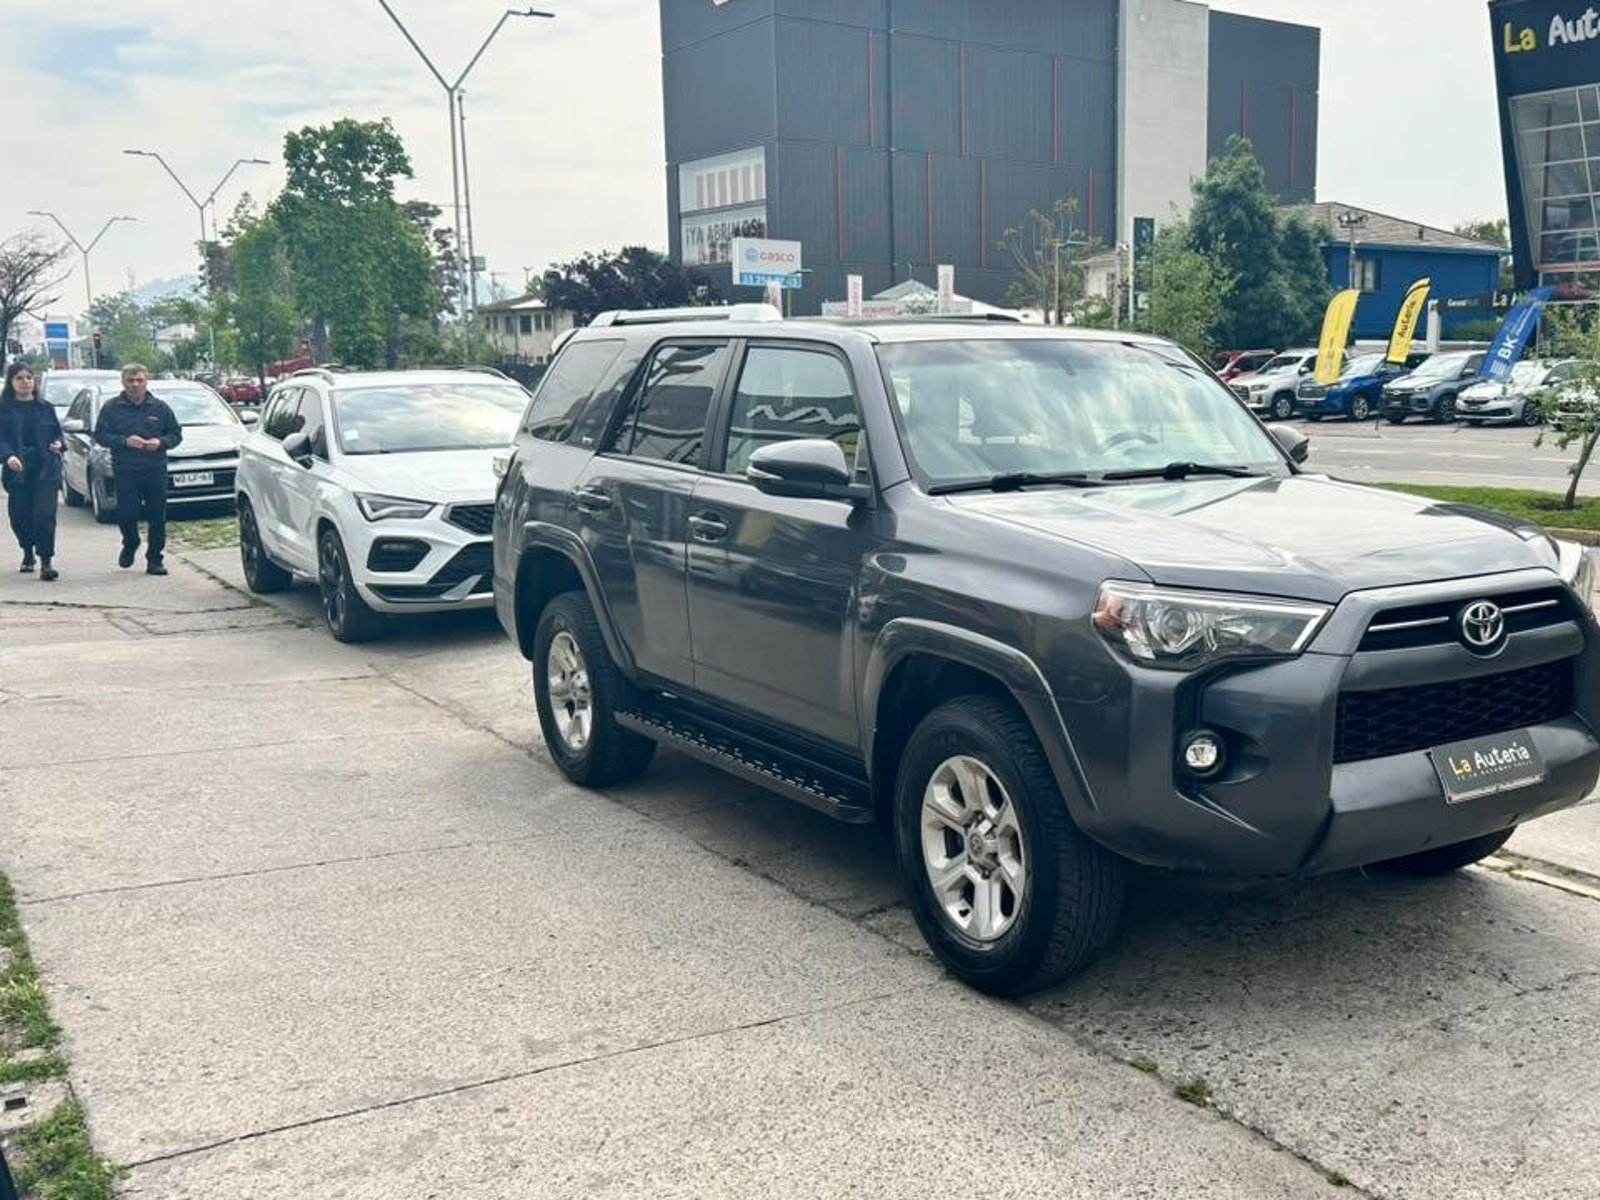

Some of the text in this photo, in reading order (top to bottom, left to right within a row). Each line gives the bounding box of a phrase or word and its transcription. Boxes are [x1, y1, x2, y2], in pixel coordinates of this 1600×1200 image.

[1504, 6, 1600, 53] La Aut
[1448, 757, 1472, 775] La
